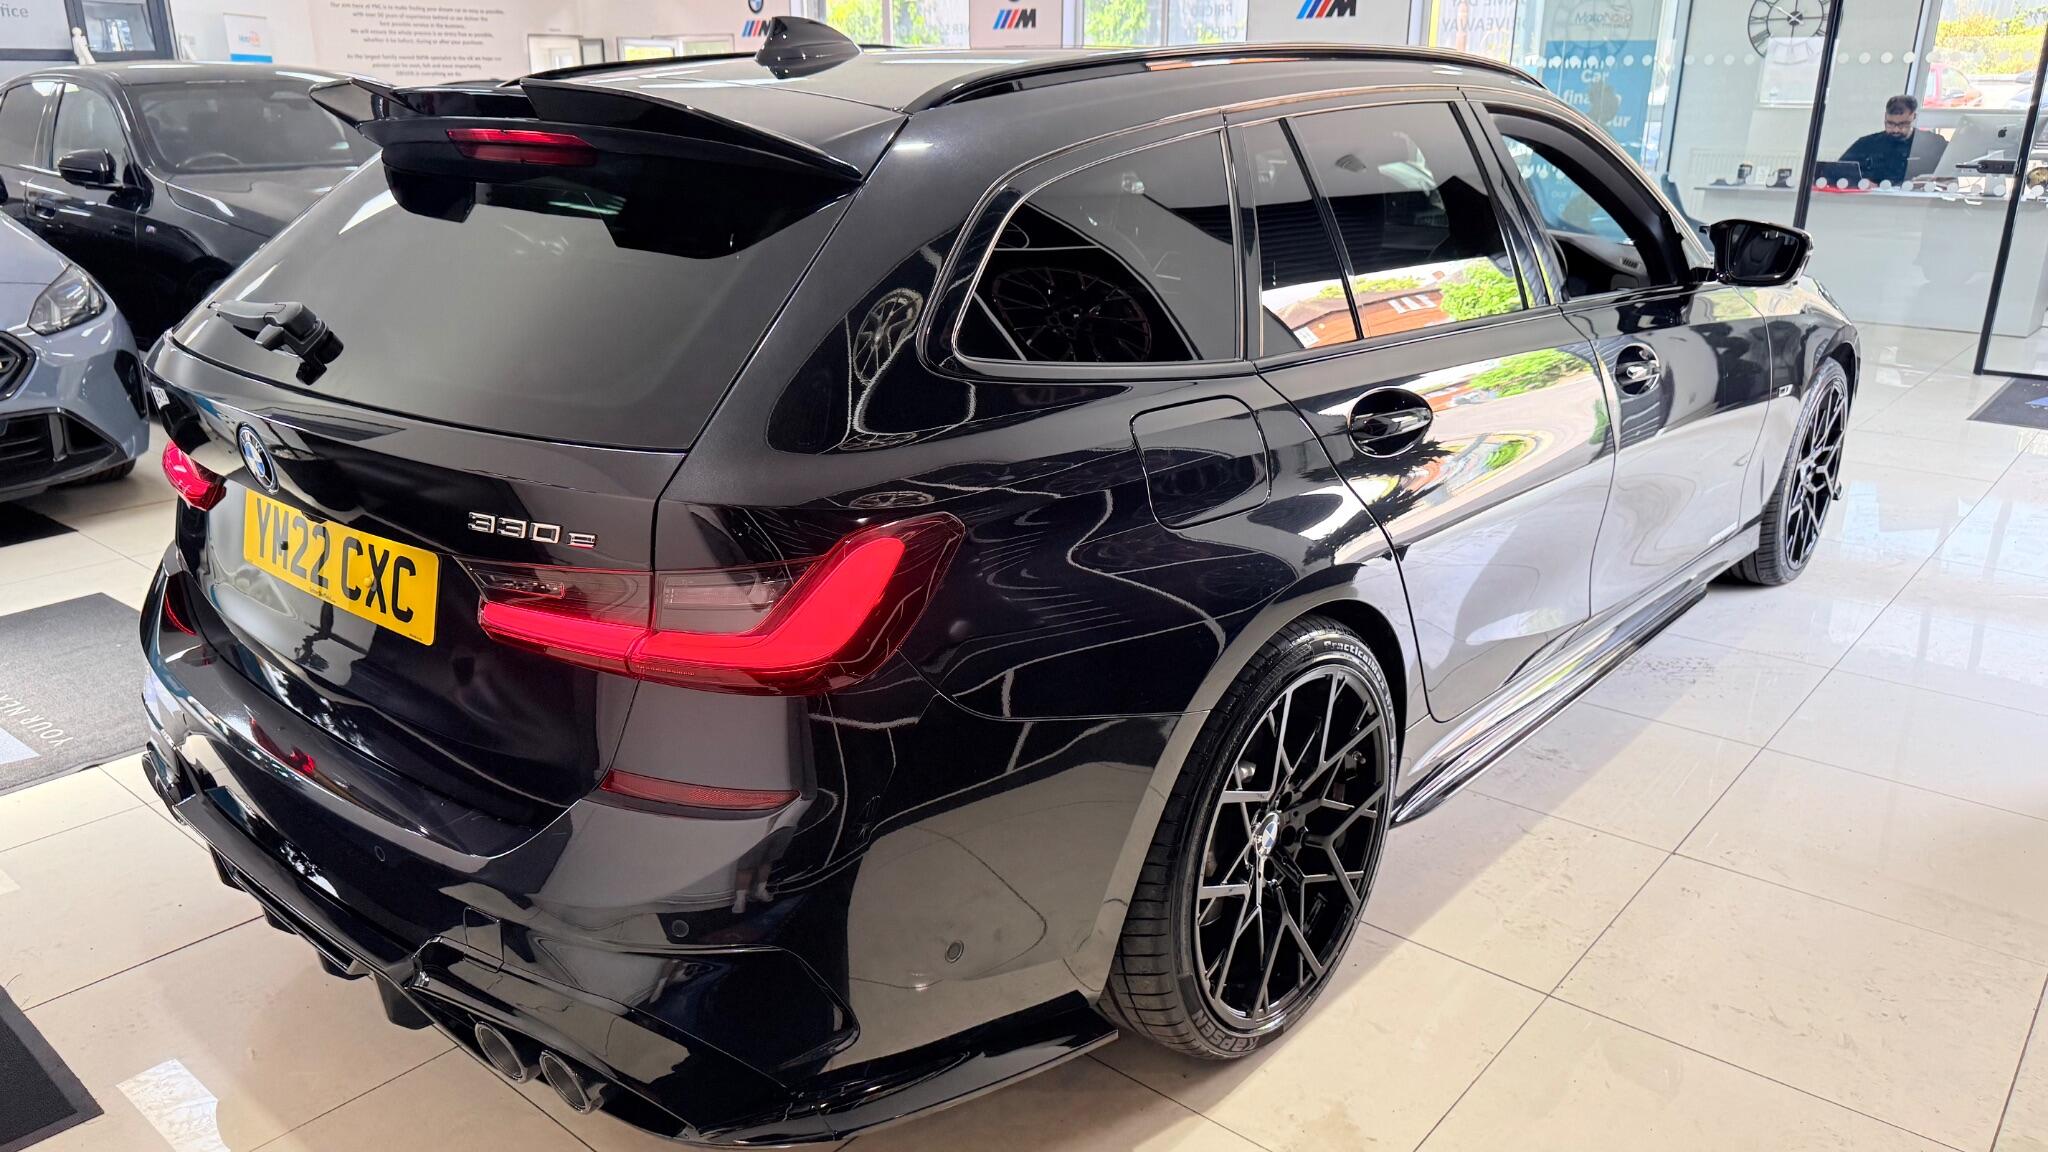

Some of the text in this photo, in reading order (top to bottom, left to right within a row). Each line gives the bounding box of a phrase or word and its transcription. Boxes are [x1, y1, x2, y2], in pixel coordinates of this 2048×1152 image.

[1580, 69, 1609, 83] Car
[256, 497, 416, 624] YM22 CXC
[20, 714, 74, 748] YOUR
